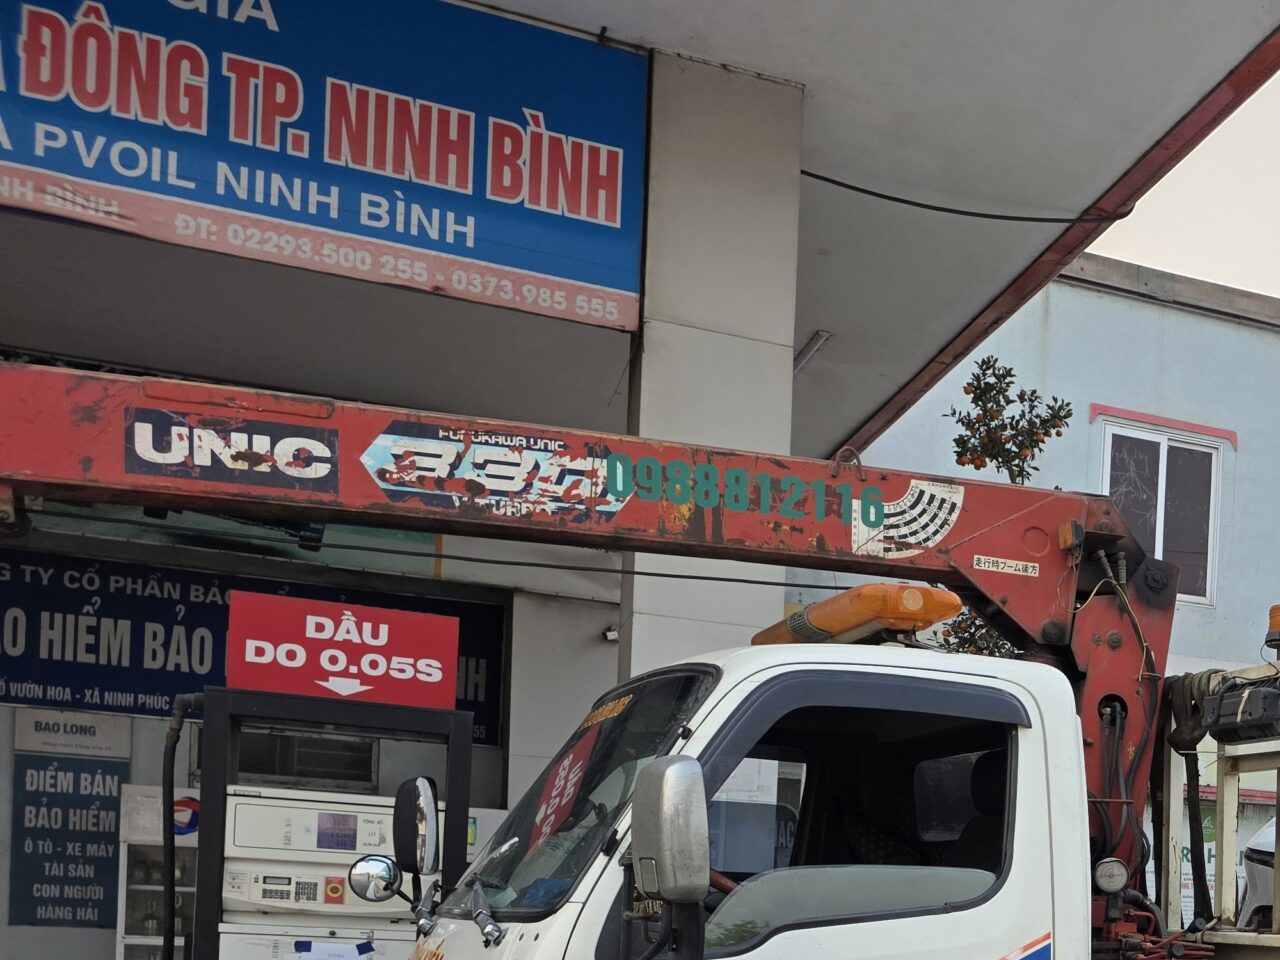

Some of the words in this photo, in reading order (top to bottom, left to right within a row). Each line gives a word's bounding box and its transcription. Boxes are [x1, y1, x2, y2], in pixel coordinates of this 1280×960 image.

[222, 52, 309, 158] TP.
[324, 78, 475, 195] NINH
[486, 108, 623, 228] BÌNH
[35, 121, 196, 189] PVOIL
[216, 161, 338, 218] NINH
[361, 190, 475, 248] BÌNH
[227, 223, 372, 272] 02293.500
[379, 255, 428, 283] 255
[452, 270, 567, 312] 0373.985
[574, 294, 619, 321] 555
[133, 421, 332, 480] UNIC
[530, 439, 565, 451] UNIC
[606, 453, 884, 529] 0988812116
[20, 564, 54, 586] TY
[63, 563, 100, 591] CỔ
[109, 572, 181, 600] PHẦN
[974, 556, 1039, 577] 走行時ブーム後方
[39, 596, 132, 668] HIỂM
[143, 604, 213, 676] BẢO
[305, 610, 389, 647] DẦU
[244, 638, 307, 669] DO
[319, 648, 444, 684] 0.05S
[10, 679, 43, 699] VƯỜN
[47, 685, 72, 702] HOA
[84, 687, 101, 706] XÃ
[104, 691, 134, 709] NINH
[137, 691, 170, 710] PHÚC
[63, 722, 97, 737] LONG
[25, 762, 74, 795] ĐIỂM
[80, 769, 119, 797] BÁN
[24, 797, 62, 829] BẢO
[69, 801, 116, 833] HIỂM
[37, 839, 53, 855] TÔ
[66, 842, 82, 857] XE
[86, 840, 115, 858] MÁY
[43, 860, 64, 878] TÀI
[68, 858, 95, 879] SẢN
[32, 883, 60, 898] CON
[64, 882, 104, 900] NGƯỜI
[36, 903, 73, 920] HÀNG
[76, 901, 98, 922] HẢI
